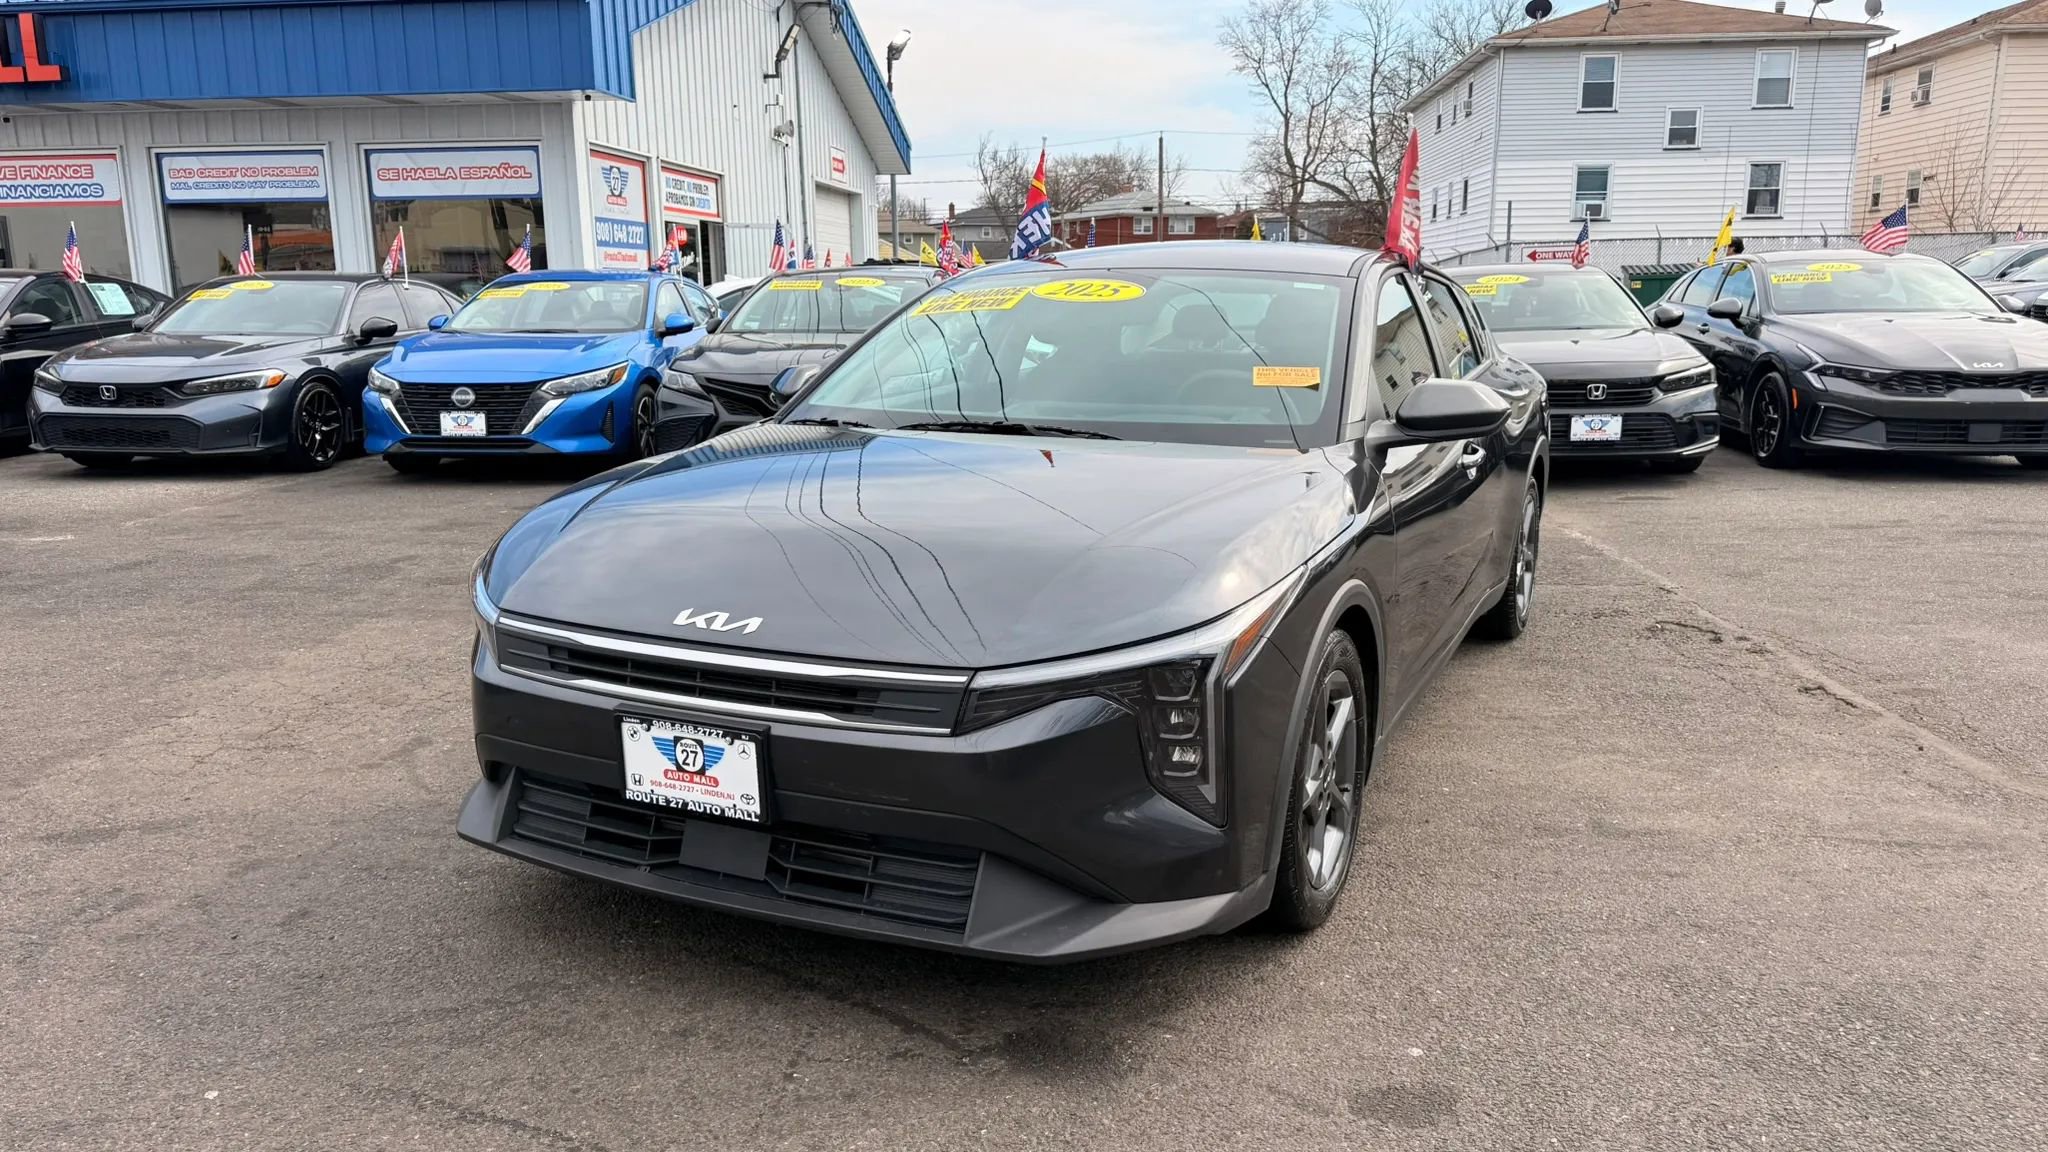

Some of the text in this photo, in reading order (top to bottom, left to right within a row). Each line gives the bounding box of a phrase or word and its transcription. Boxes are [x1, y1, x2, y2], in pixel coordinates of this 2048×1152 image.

[18, 164, 93, 180] FINANCE
[169, 166, 319, 179] BAD CREDIT NO PROBLEM
[377, 162, 533, 181] SE HABLA ESPAÑOL
[171, 182, 192, 191] MAL
[232, 181, 246, 190] NO
[247, 180, 268, 189] HAY
[269, 179, 319, 189] PROBLEMA
[612, 176, 620, 192] 27
[613, 223, 628, 243] 648
[628, 226, 644, 245] 2727
[1535, 251, 1573, 259] ONE WAY
[952, 287, 1029, 302] FINANCE
[1047, 282, 1129, 298] 2025
[920, 296, 1012, 314] LIKE NEW
[672, 607, 764, 635] KIA
[652, 720, 724, 739] 908-648-2727
[679, 742, 698, 750] ROUTE
[681, 749, 698, 768] 27
[650, 779, 695, 793] 908-648-2727
[667, 770, 717, 787] AUTO MALL
[626, 790, 760, 822] ROUTE 27 AUTO MALL
